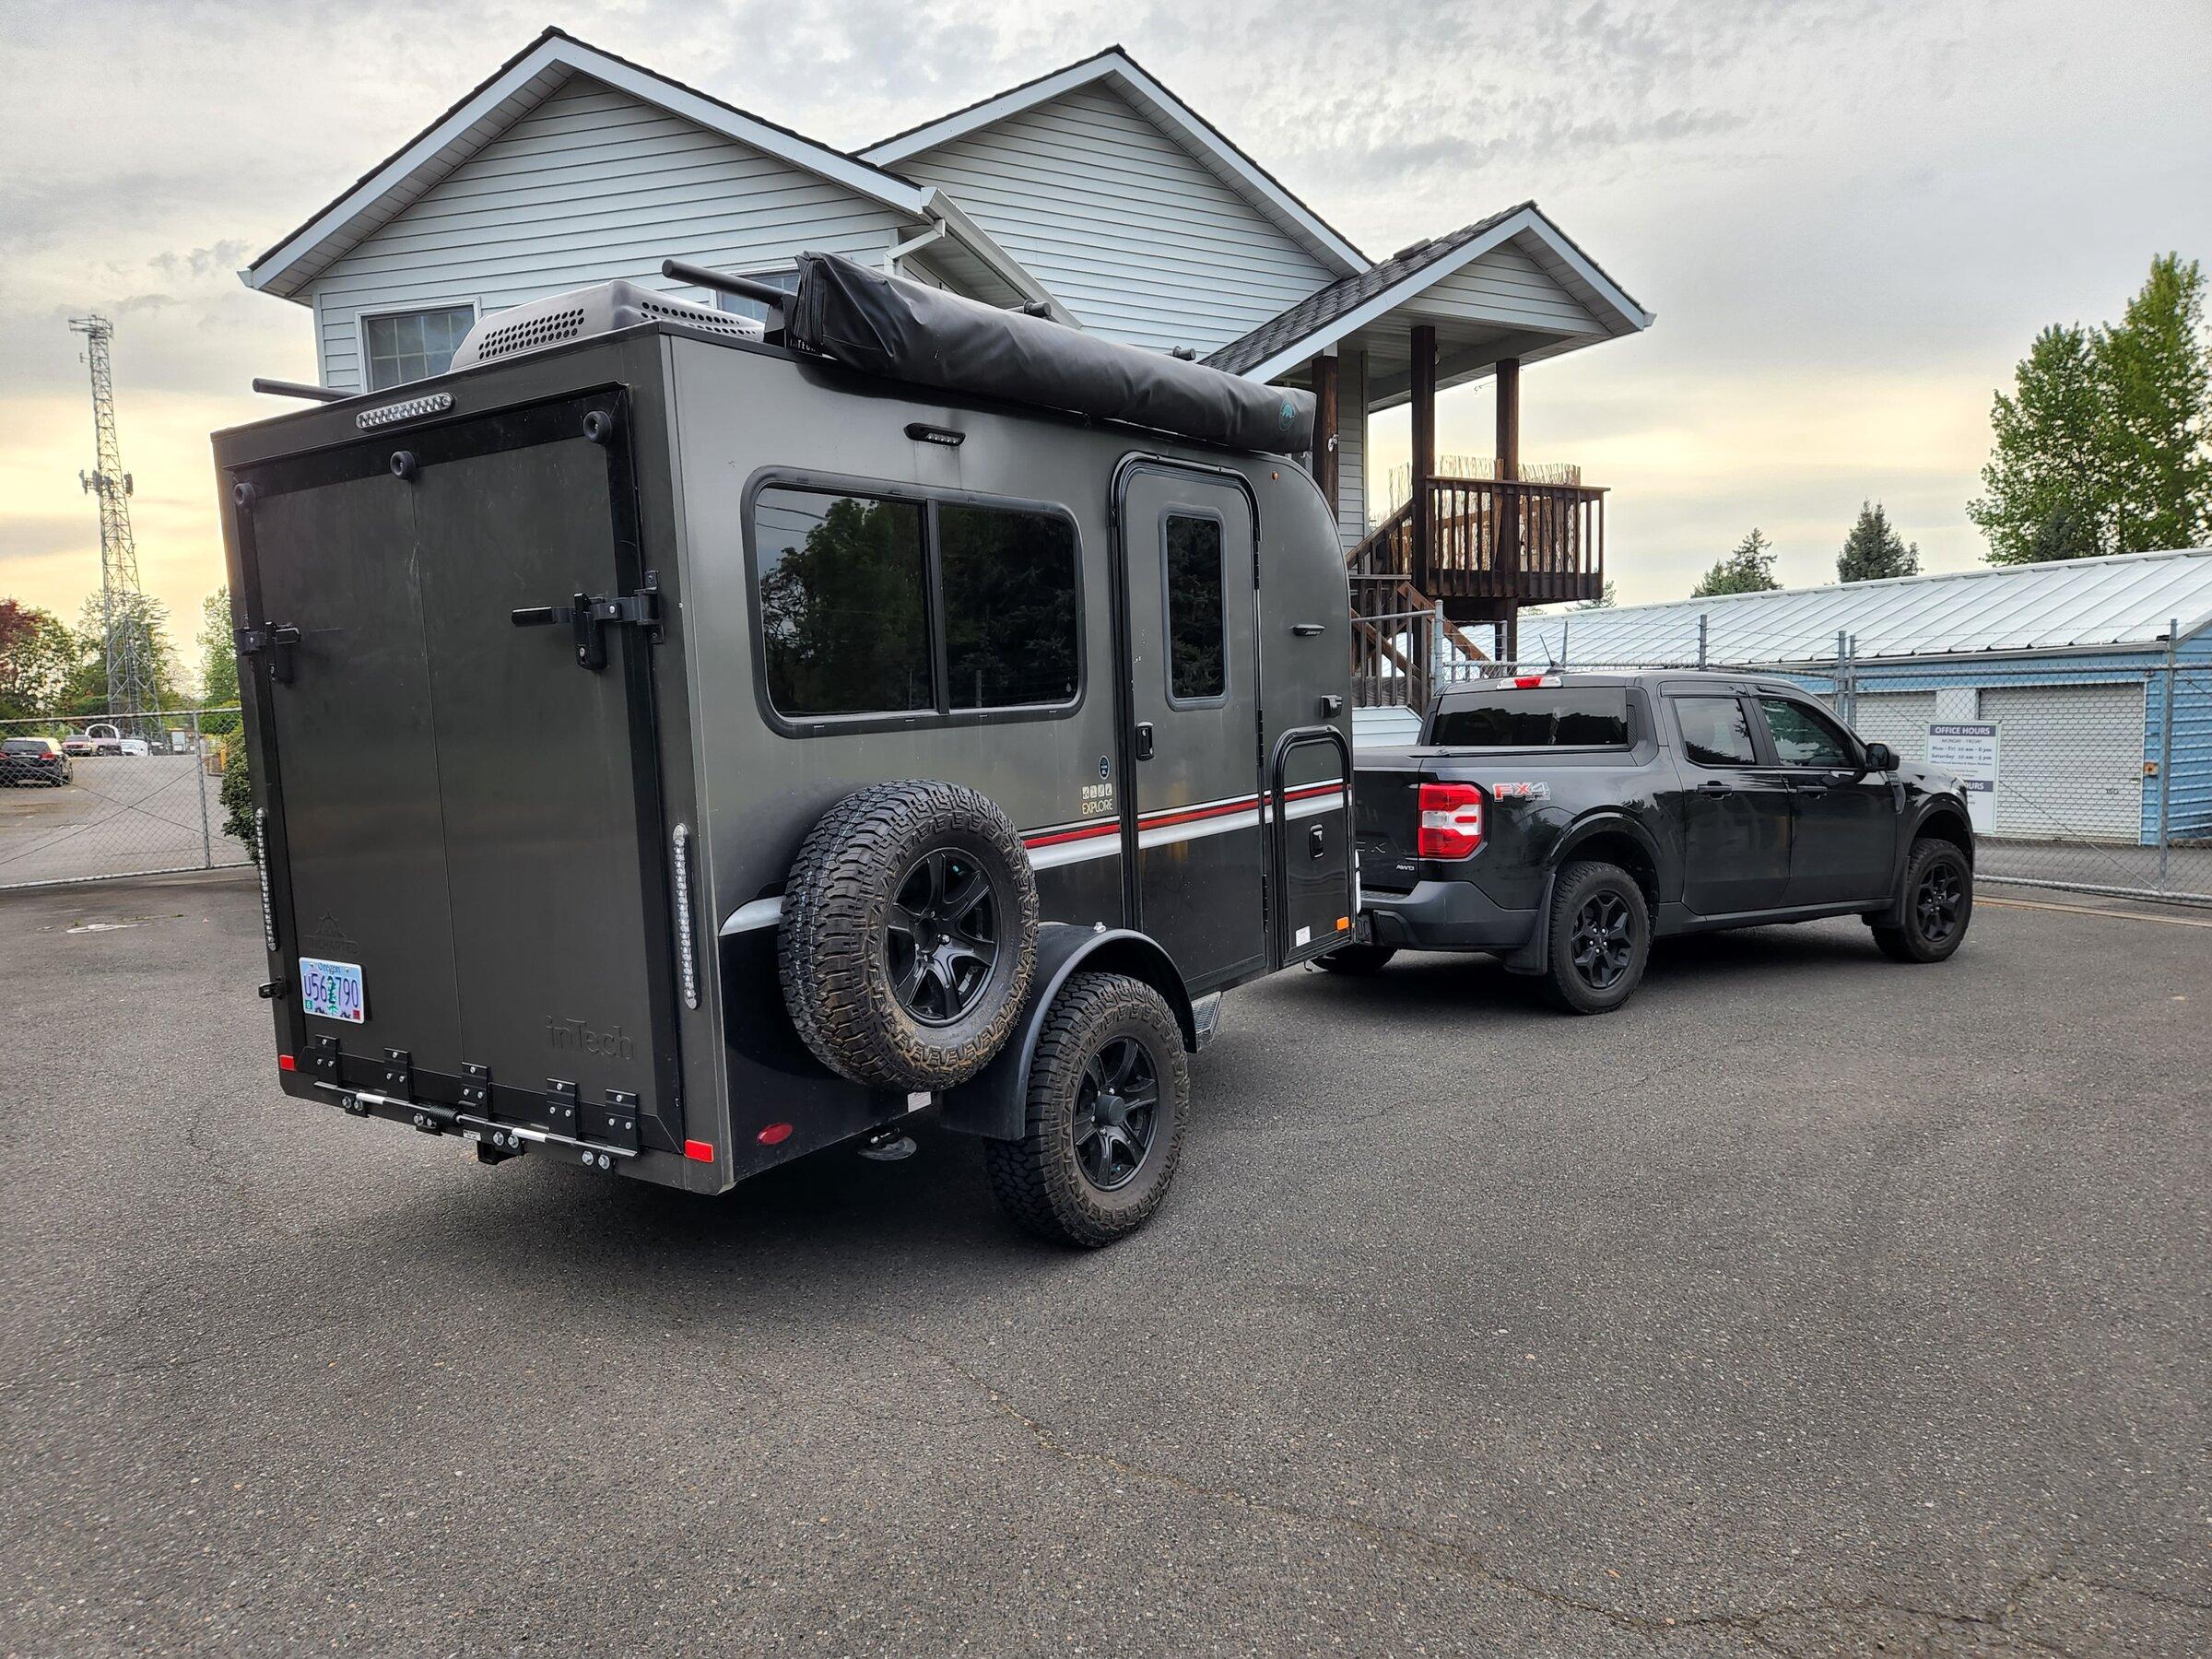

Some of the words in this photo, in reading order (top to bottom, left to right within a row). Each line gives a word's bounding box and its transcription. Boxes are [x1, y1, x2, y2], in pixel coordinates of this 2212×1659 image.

[1492, 781, 1551, 803] FX4
[1082, 799, 1114, 814] EXPLORE
[317, 962, 342, 975] Oregon
[546, 1014, 634, 1060] inTech
